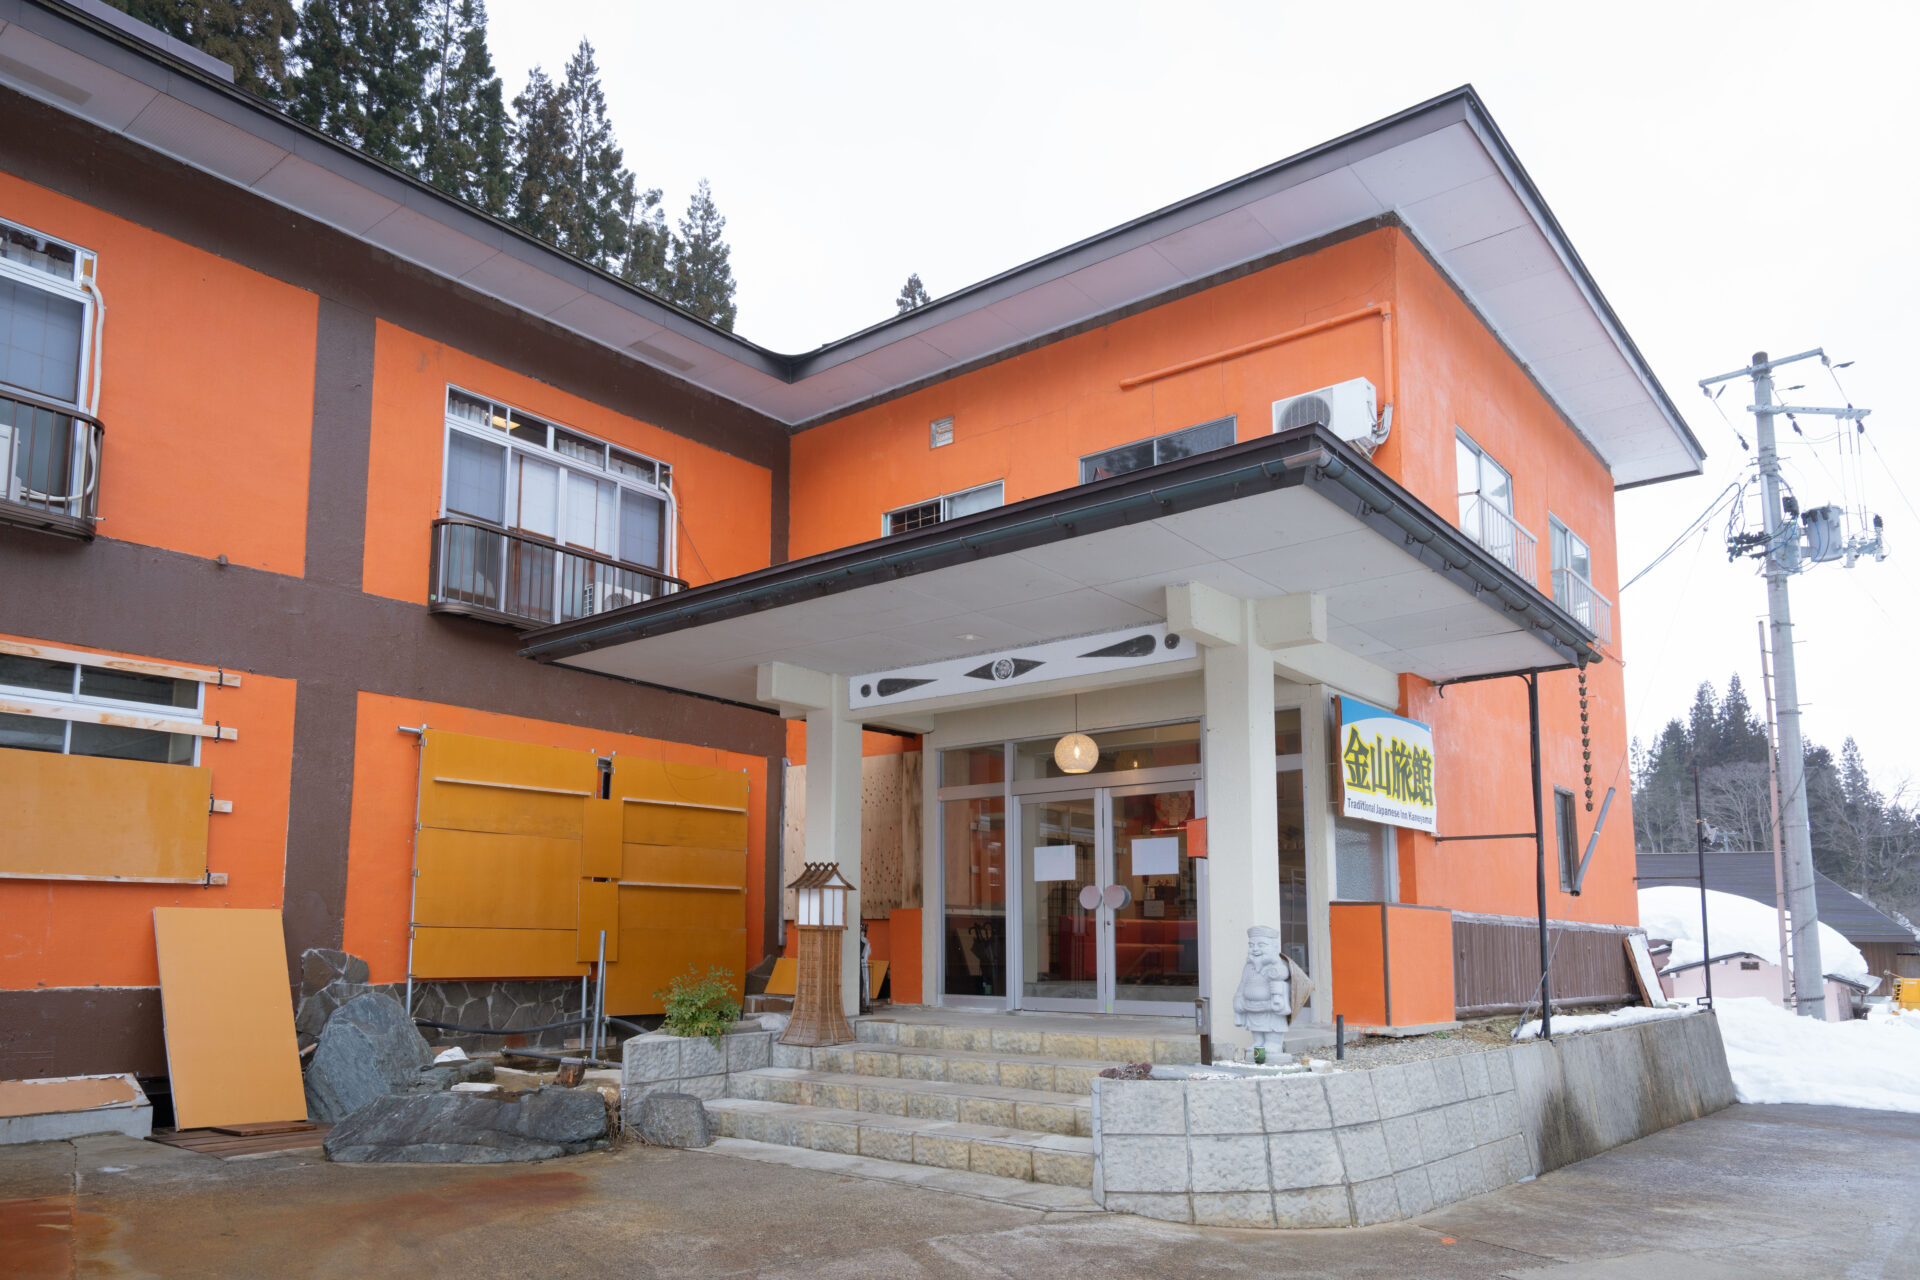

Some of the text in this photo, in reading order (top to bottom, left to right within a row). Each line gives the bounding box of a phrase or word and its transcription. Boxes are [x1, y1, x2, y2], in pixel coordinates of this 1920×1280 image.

[1344, 725, 1434, 808] 金山旅館
[1347, 797, 1375, 813] Traditional
[1376, 804, 1400, 818] Japanese
